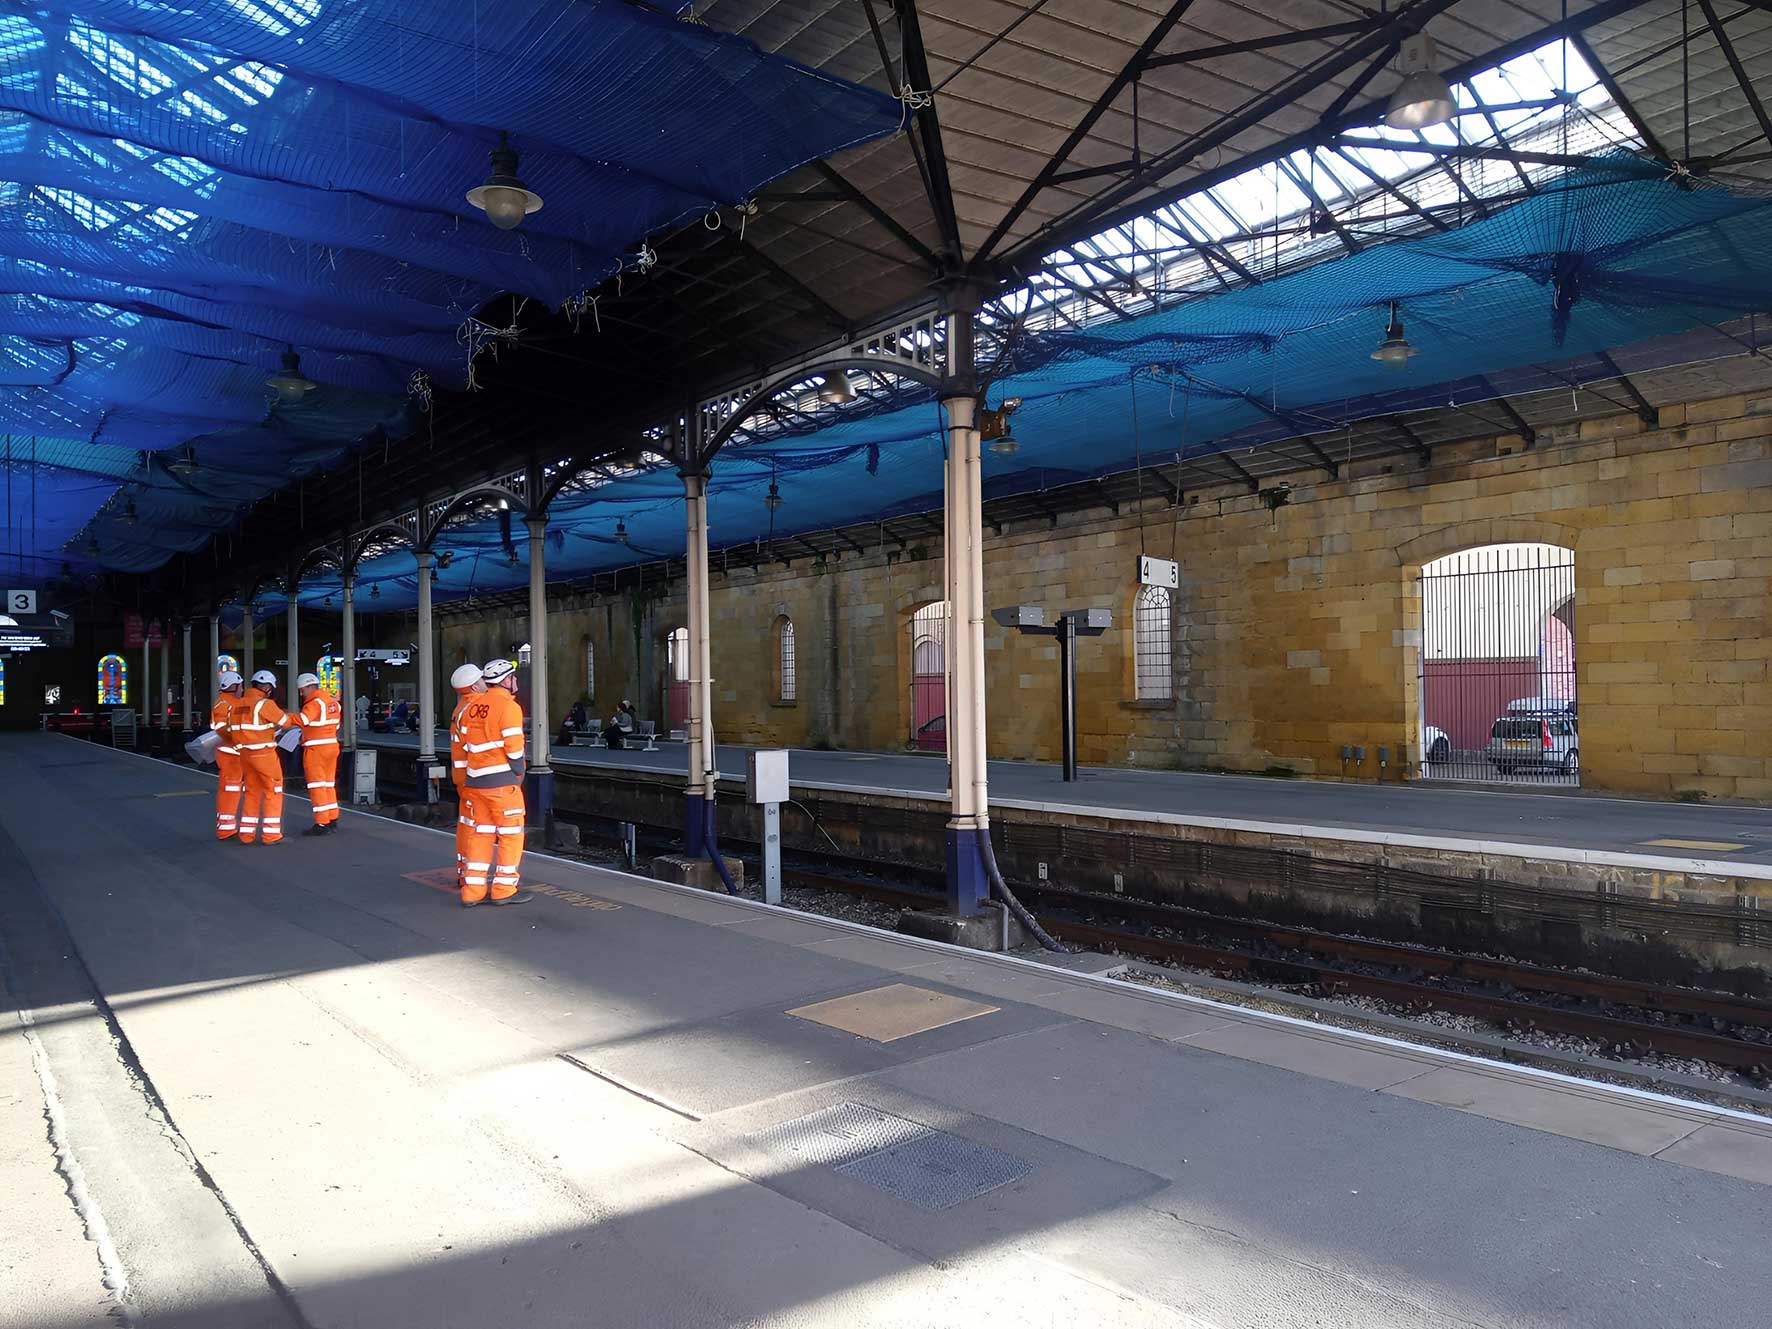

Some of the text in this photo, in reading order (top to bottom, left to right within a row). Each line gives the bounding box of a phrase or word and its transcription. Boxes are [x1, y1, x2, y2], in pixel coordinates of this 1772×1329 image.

[1143, 561, 1176, 583] 4 5
[15, 594, 29, 609] 3
[392, 651, 399, 659] 5
